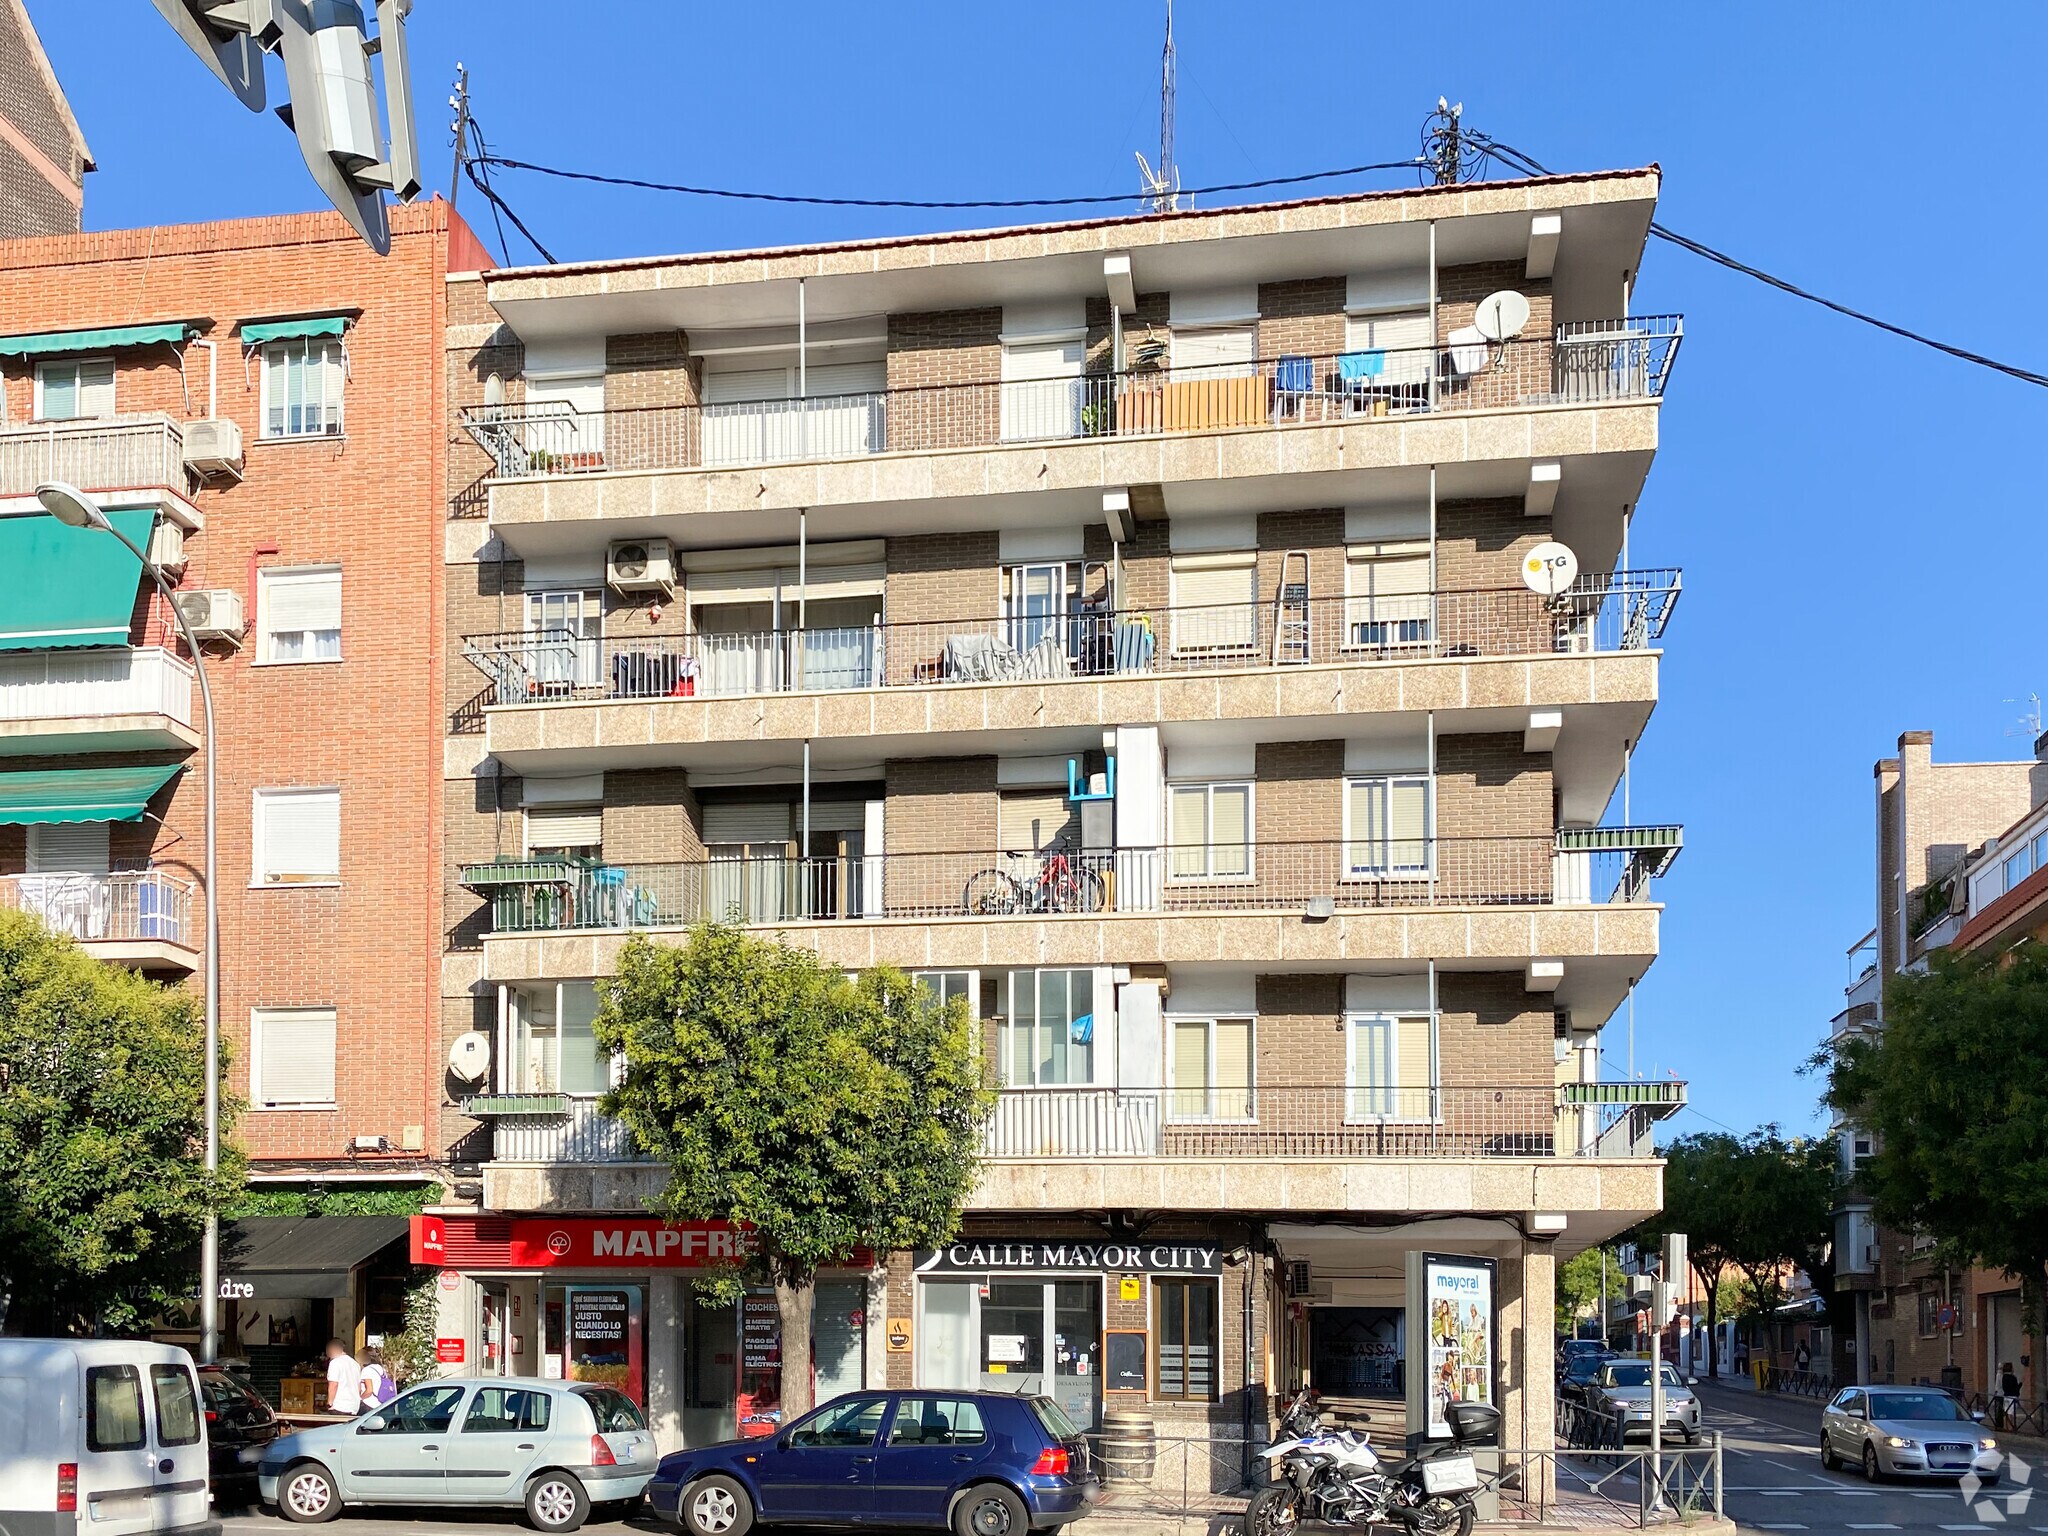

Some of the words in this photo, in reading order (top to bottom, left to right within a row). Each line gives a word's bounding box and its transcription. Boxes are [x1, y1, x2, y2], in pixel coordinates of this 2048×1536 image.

[423, 1241, 444, 1251] MAPFRE
[949, 1243, 1034, 1267] CALLE
[1041, 1244, 1143, 1268] MAYOR
[1150, 1246, 1216, 1269] CITY
[1437, 1274, 1479, 1291] mayoral
[745, 1303, 778, 1312] COCHES
[575, 1312, 602, 1321] JUSTO
[575, 1321, 609, 1330] CUANDO
[610, 1321, 621, 1330] LO
[575, 1330, 622, 1339] NECESITAS?
